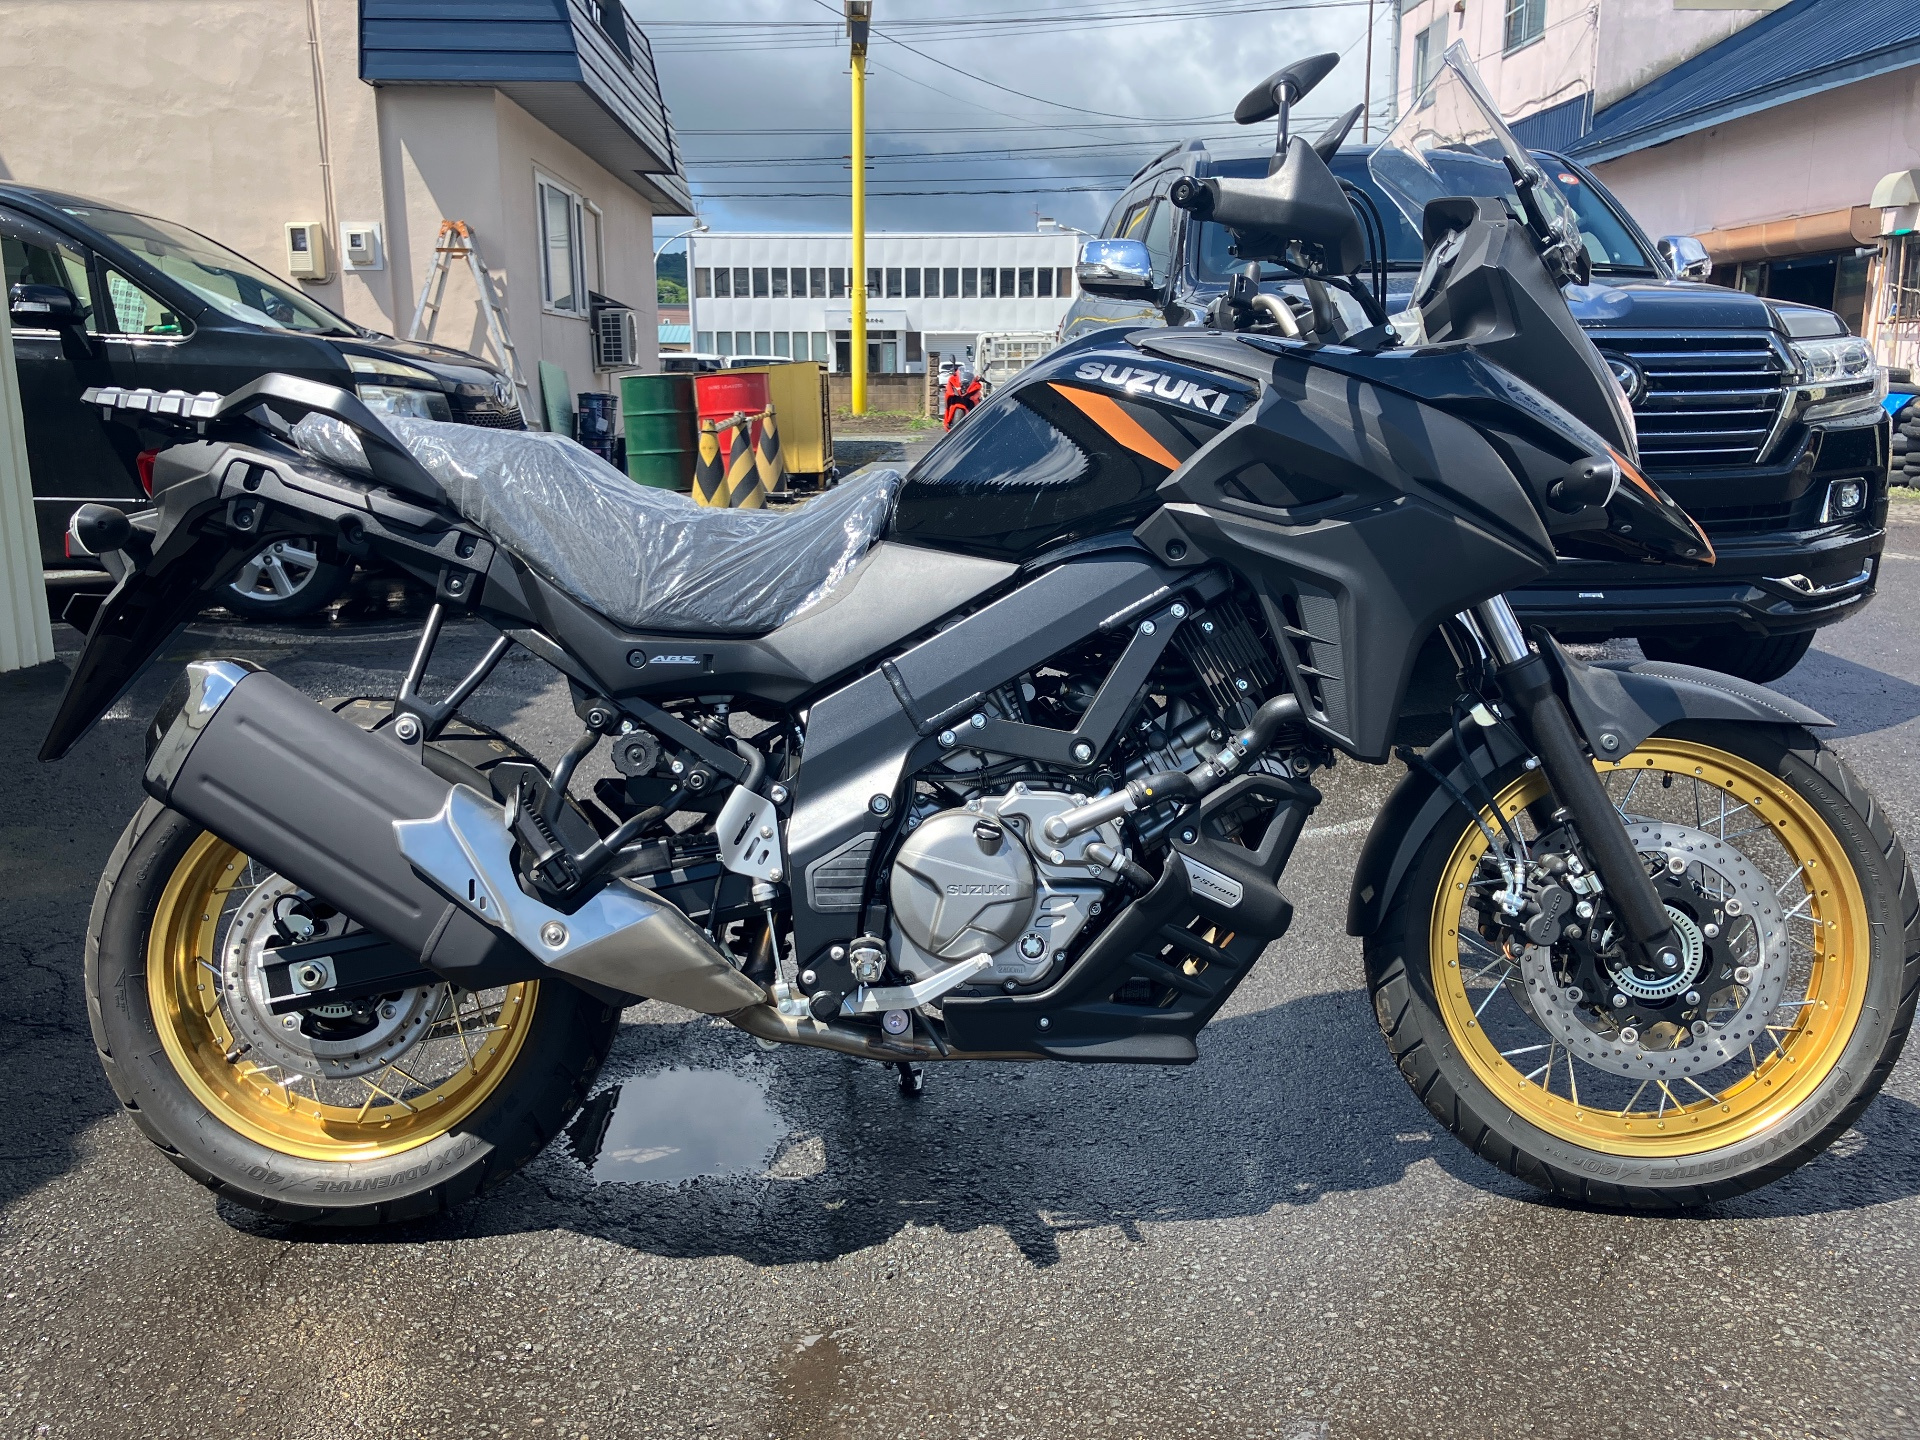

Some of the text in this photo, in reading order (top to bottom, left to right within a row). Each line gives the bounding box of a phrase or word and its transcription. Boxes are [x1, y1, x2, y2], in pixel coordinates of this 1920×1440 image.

[1075, 362, 1229, 415] SUZUKI
[649, 655, 697, 663] ABS
[946, 884, 1011, 896] SUZUKI
[1540, 893, 1562, 939] TOKICO
[315, 1161, 434, 1193] ADVENTURE
[1649, 1147, 1768, 1181] ADVENTURE
